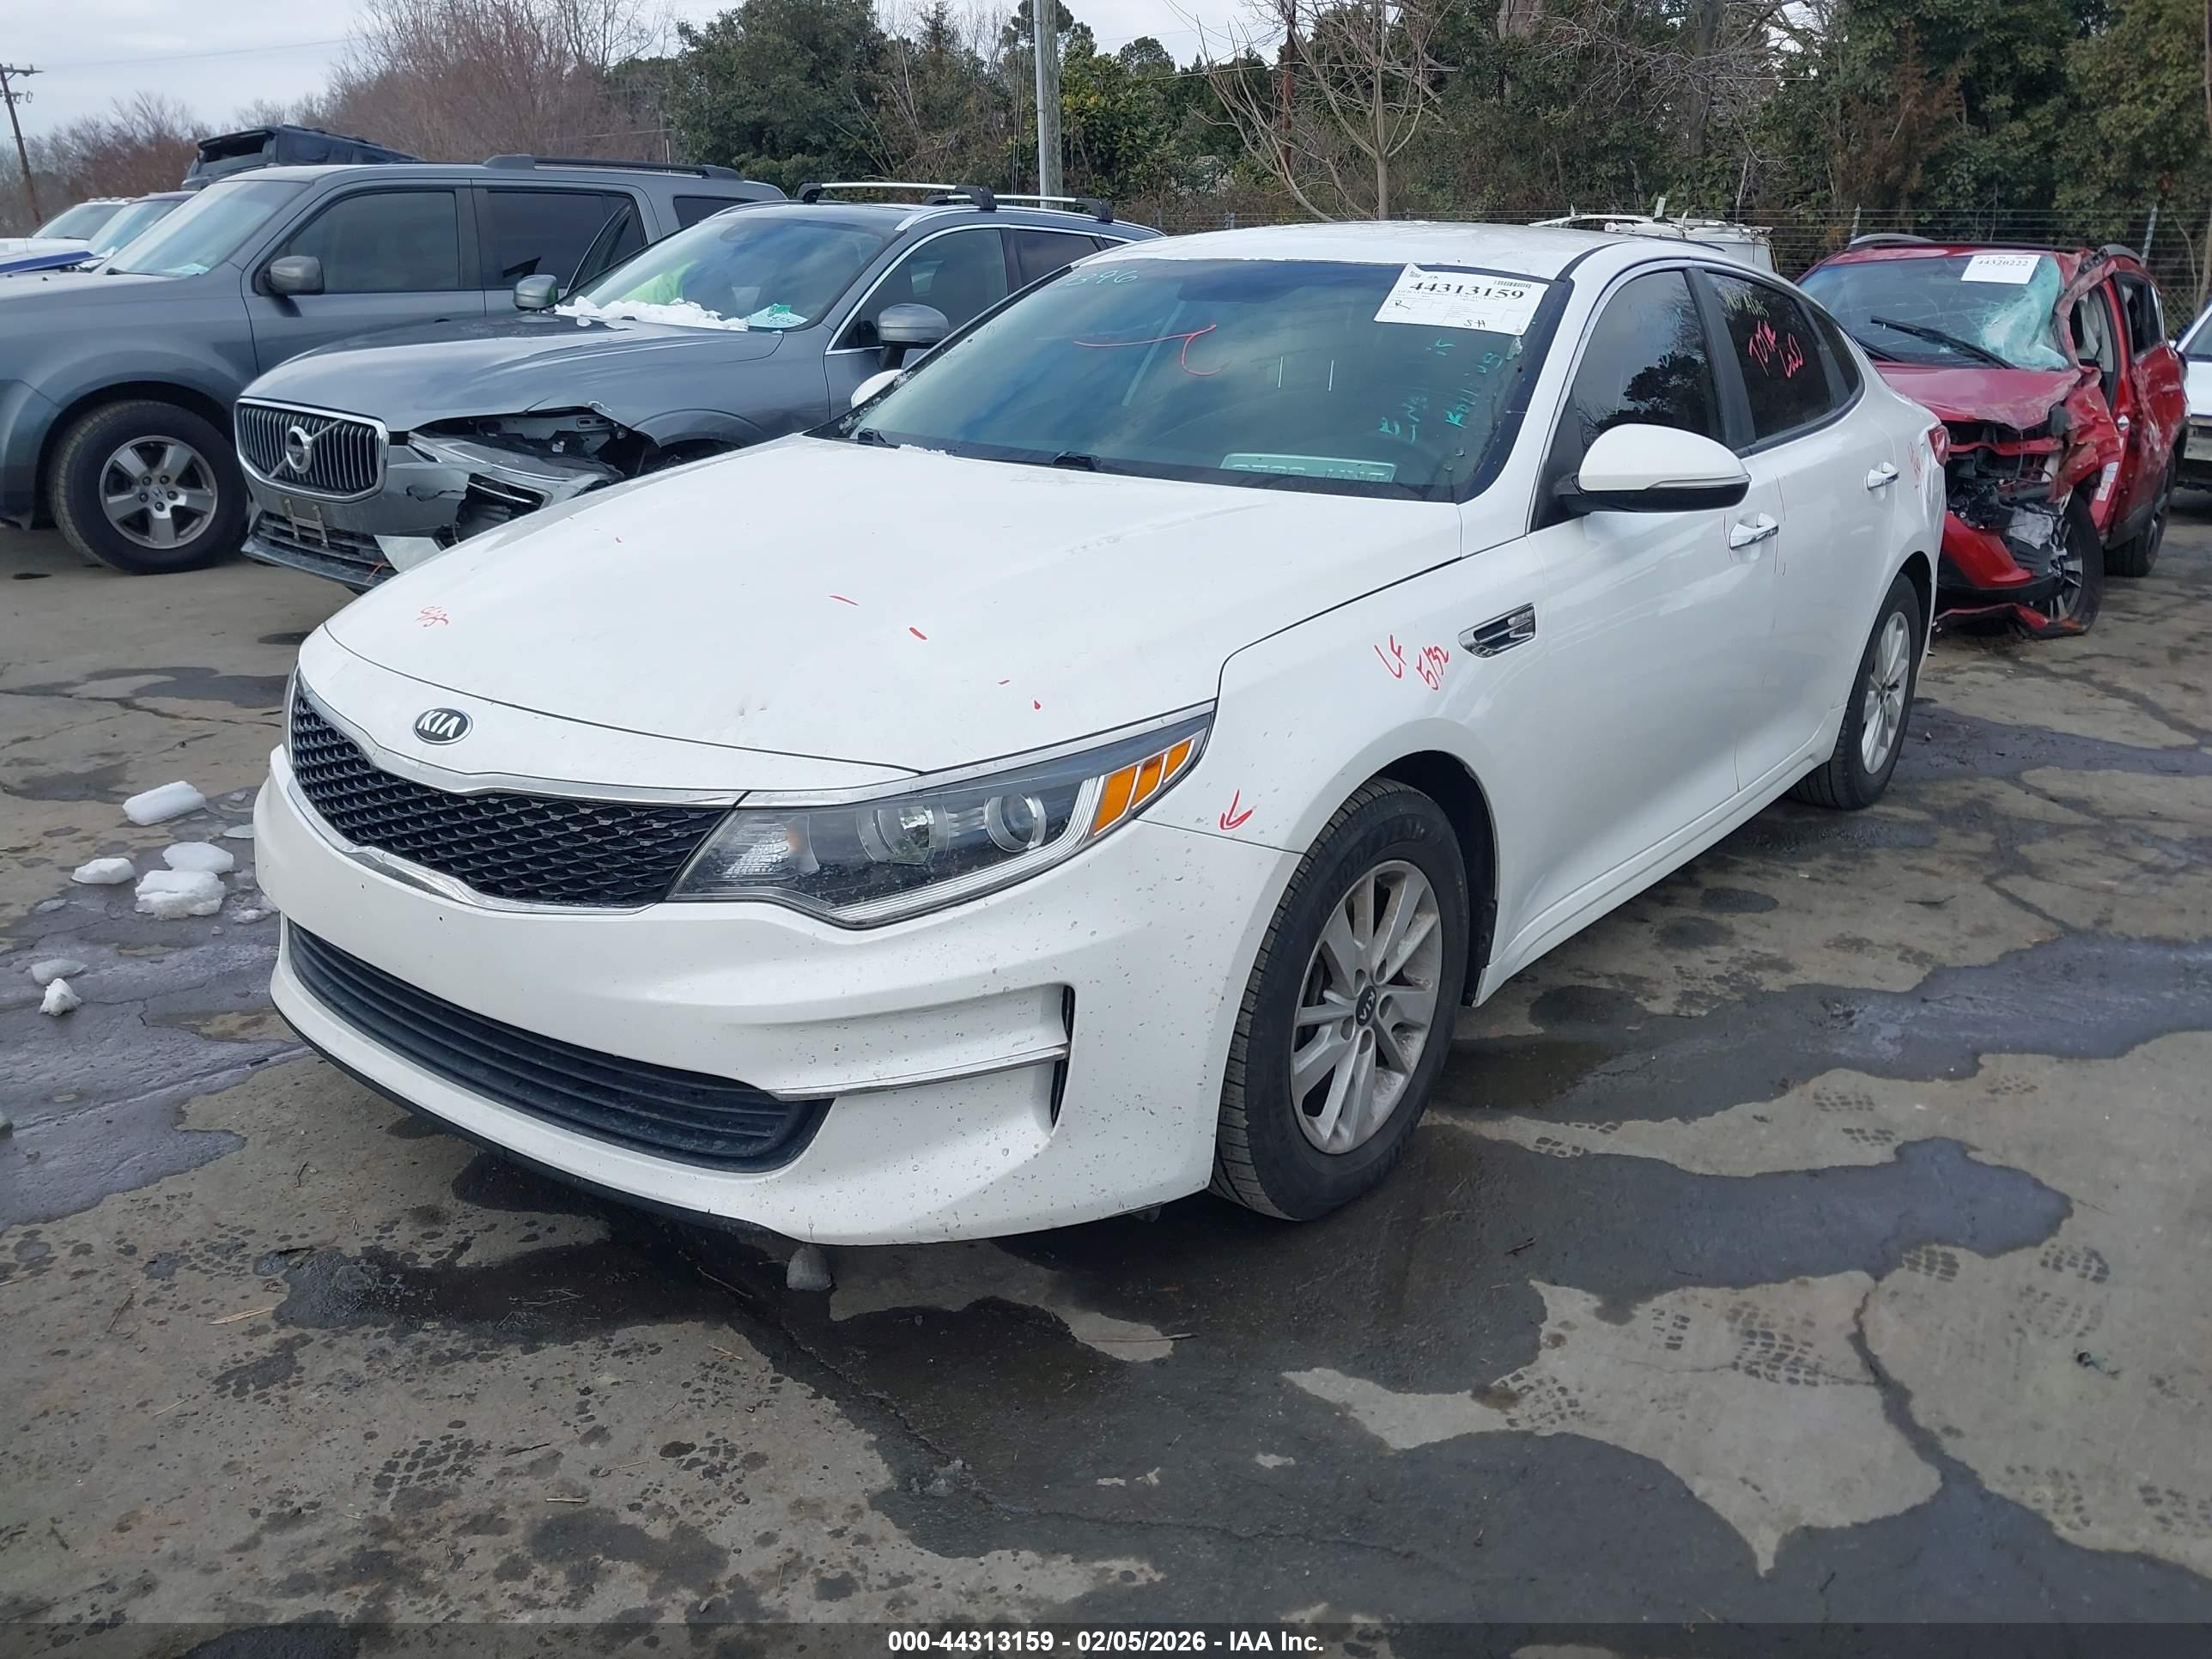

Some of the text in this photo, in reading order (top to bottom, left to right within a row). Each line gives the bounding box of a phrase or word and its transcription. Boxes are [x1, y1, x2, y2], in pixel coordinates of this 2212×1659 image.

[1409, 282, 1525, 301] 44313159
[417, 710, 461, 738] KIA
[1359, 991, 1376, 1019] KIA
